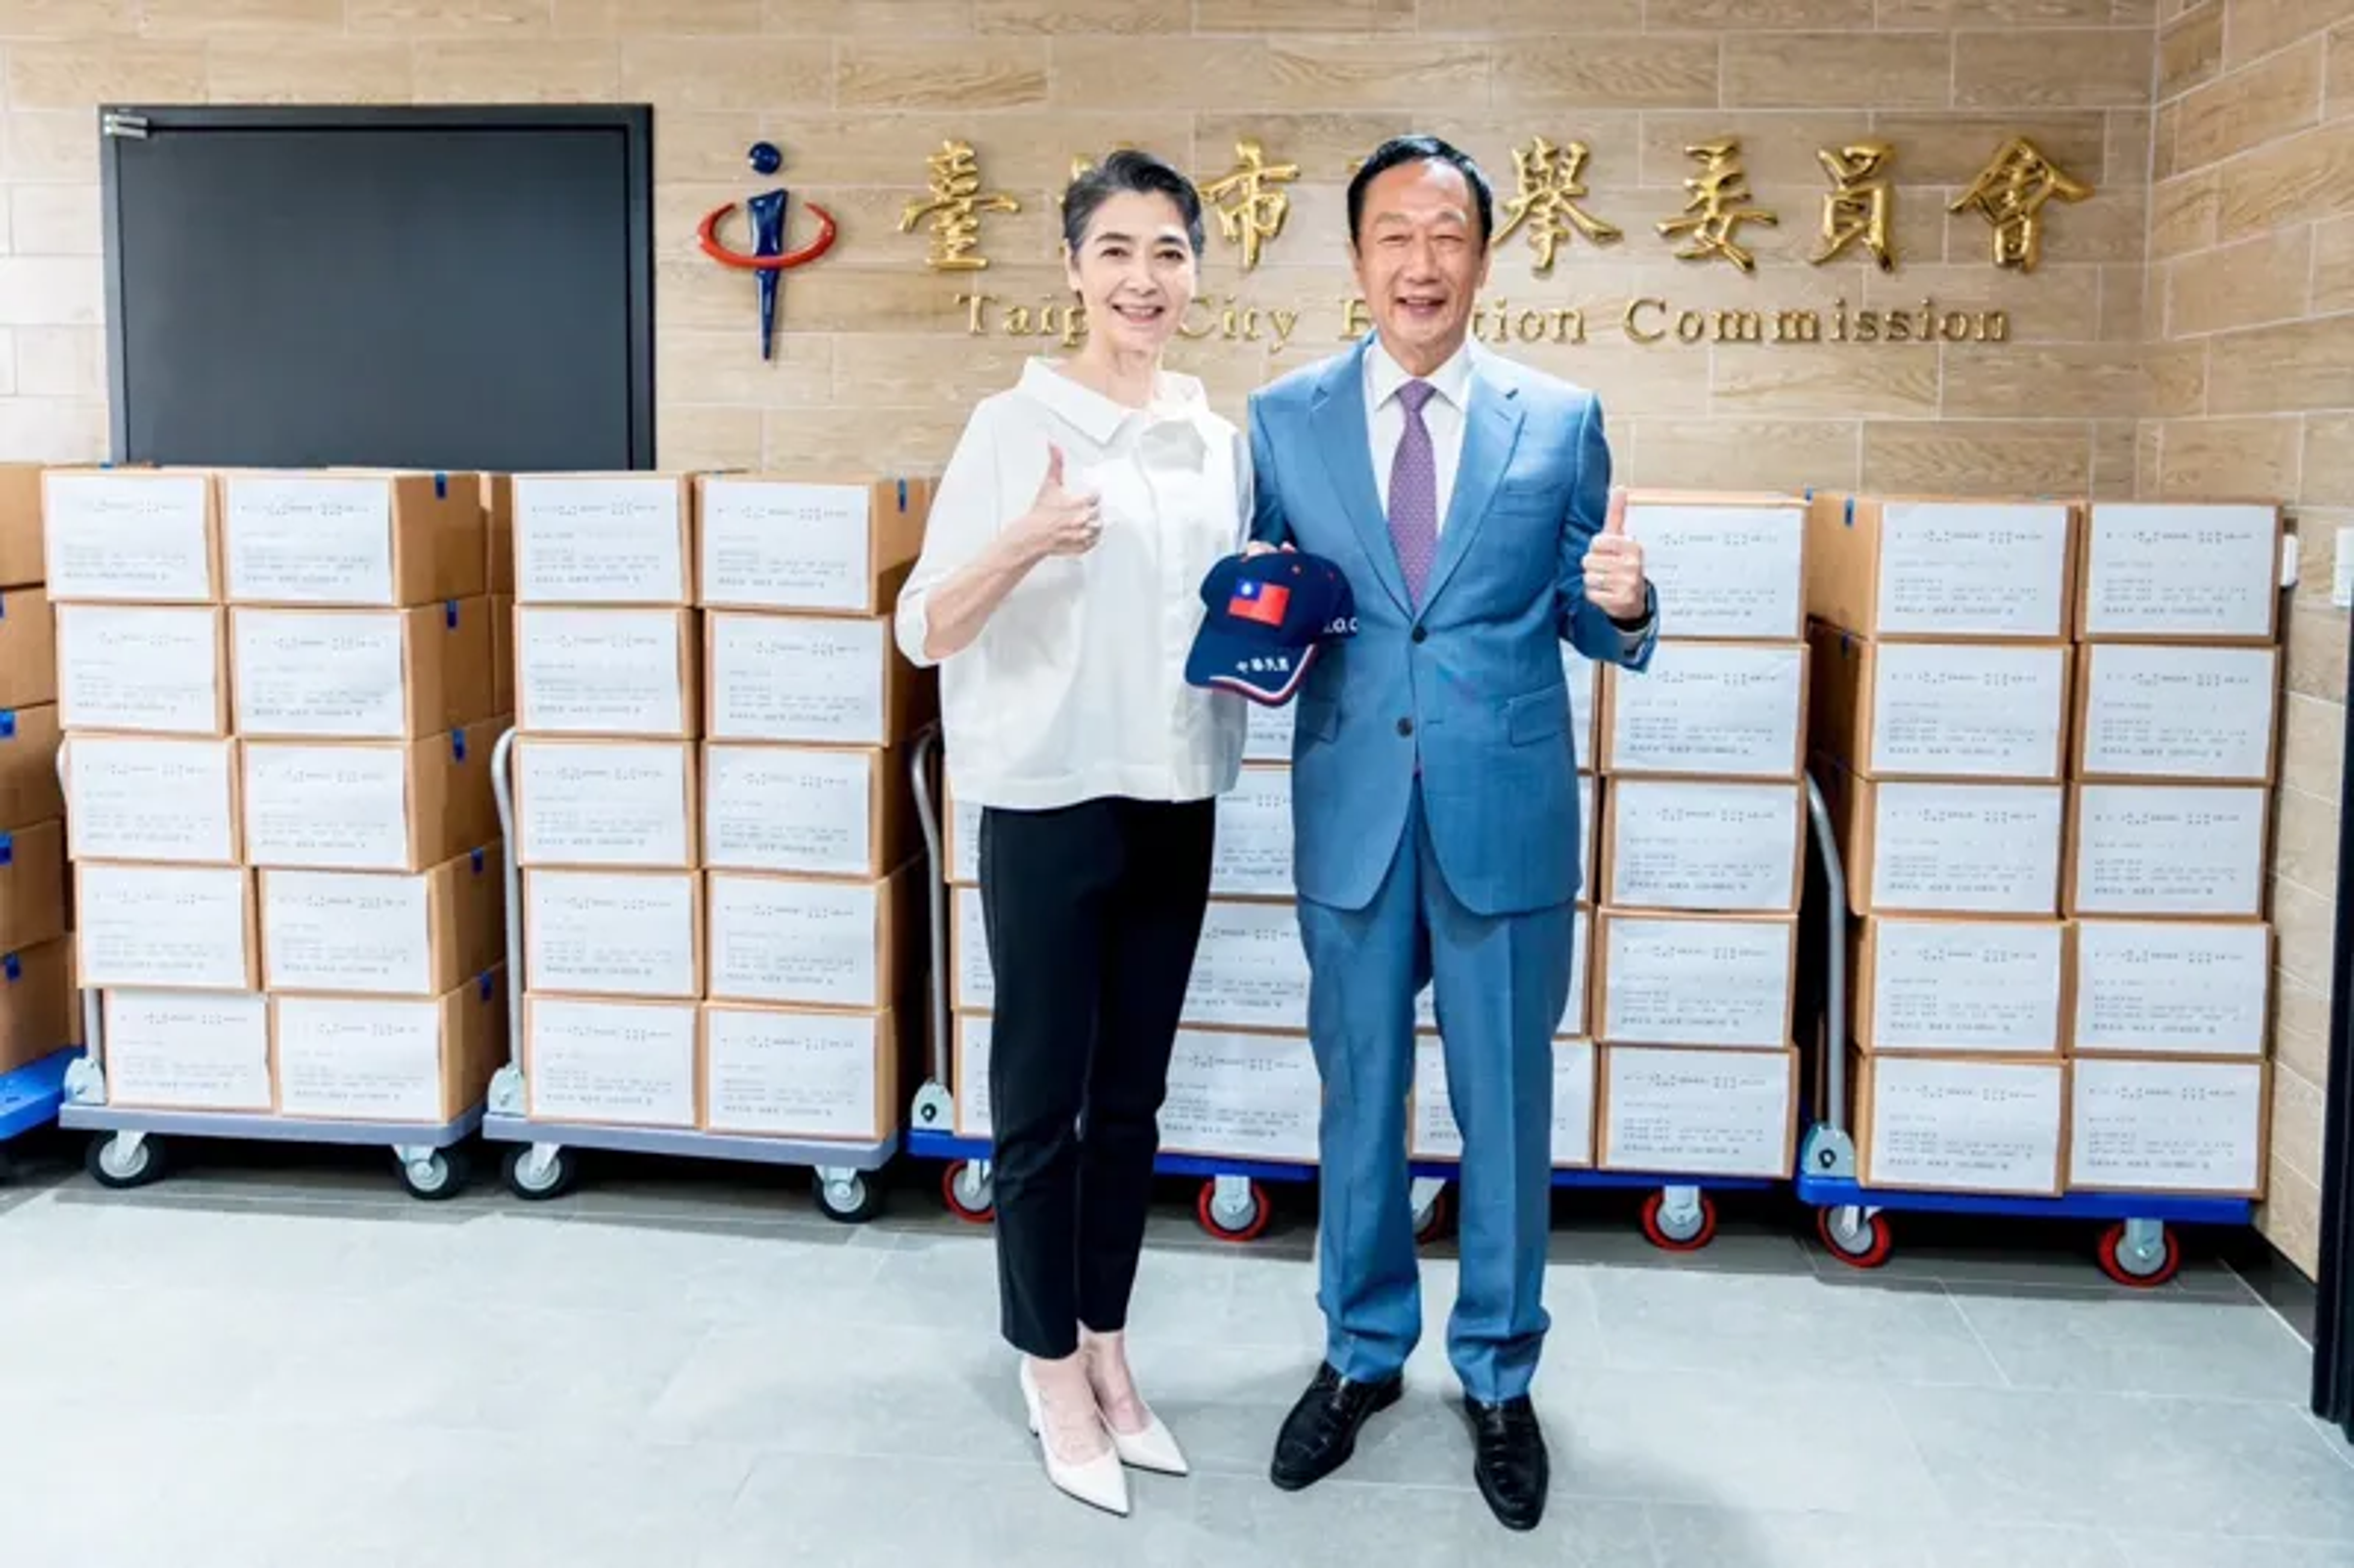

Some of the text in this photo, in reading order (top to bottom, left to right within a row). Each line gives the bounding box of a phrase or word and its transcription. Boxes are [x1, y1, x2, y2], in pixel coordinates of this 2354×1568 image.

[896, 135, 2095, 277] 臺市舉委員會
[953, 293, 2011, 354] Taip City Etion Commission
